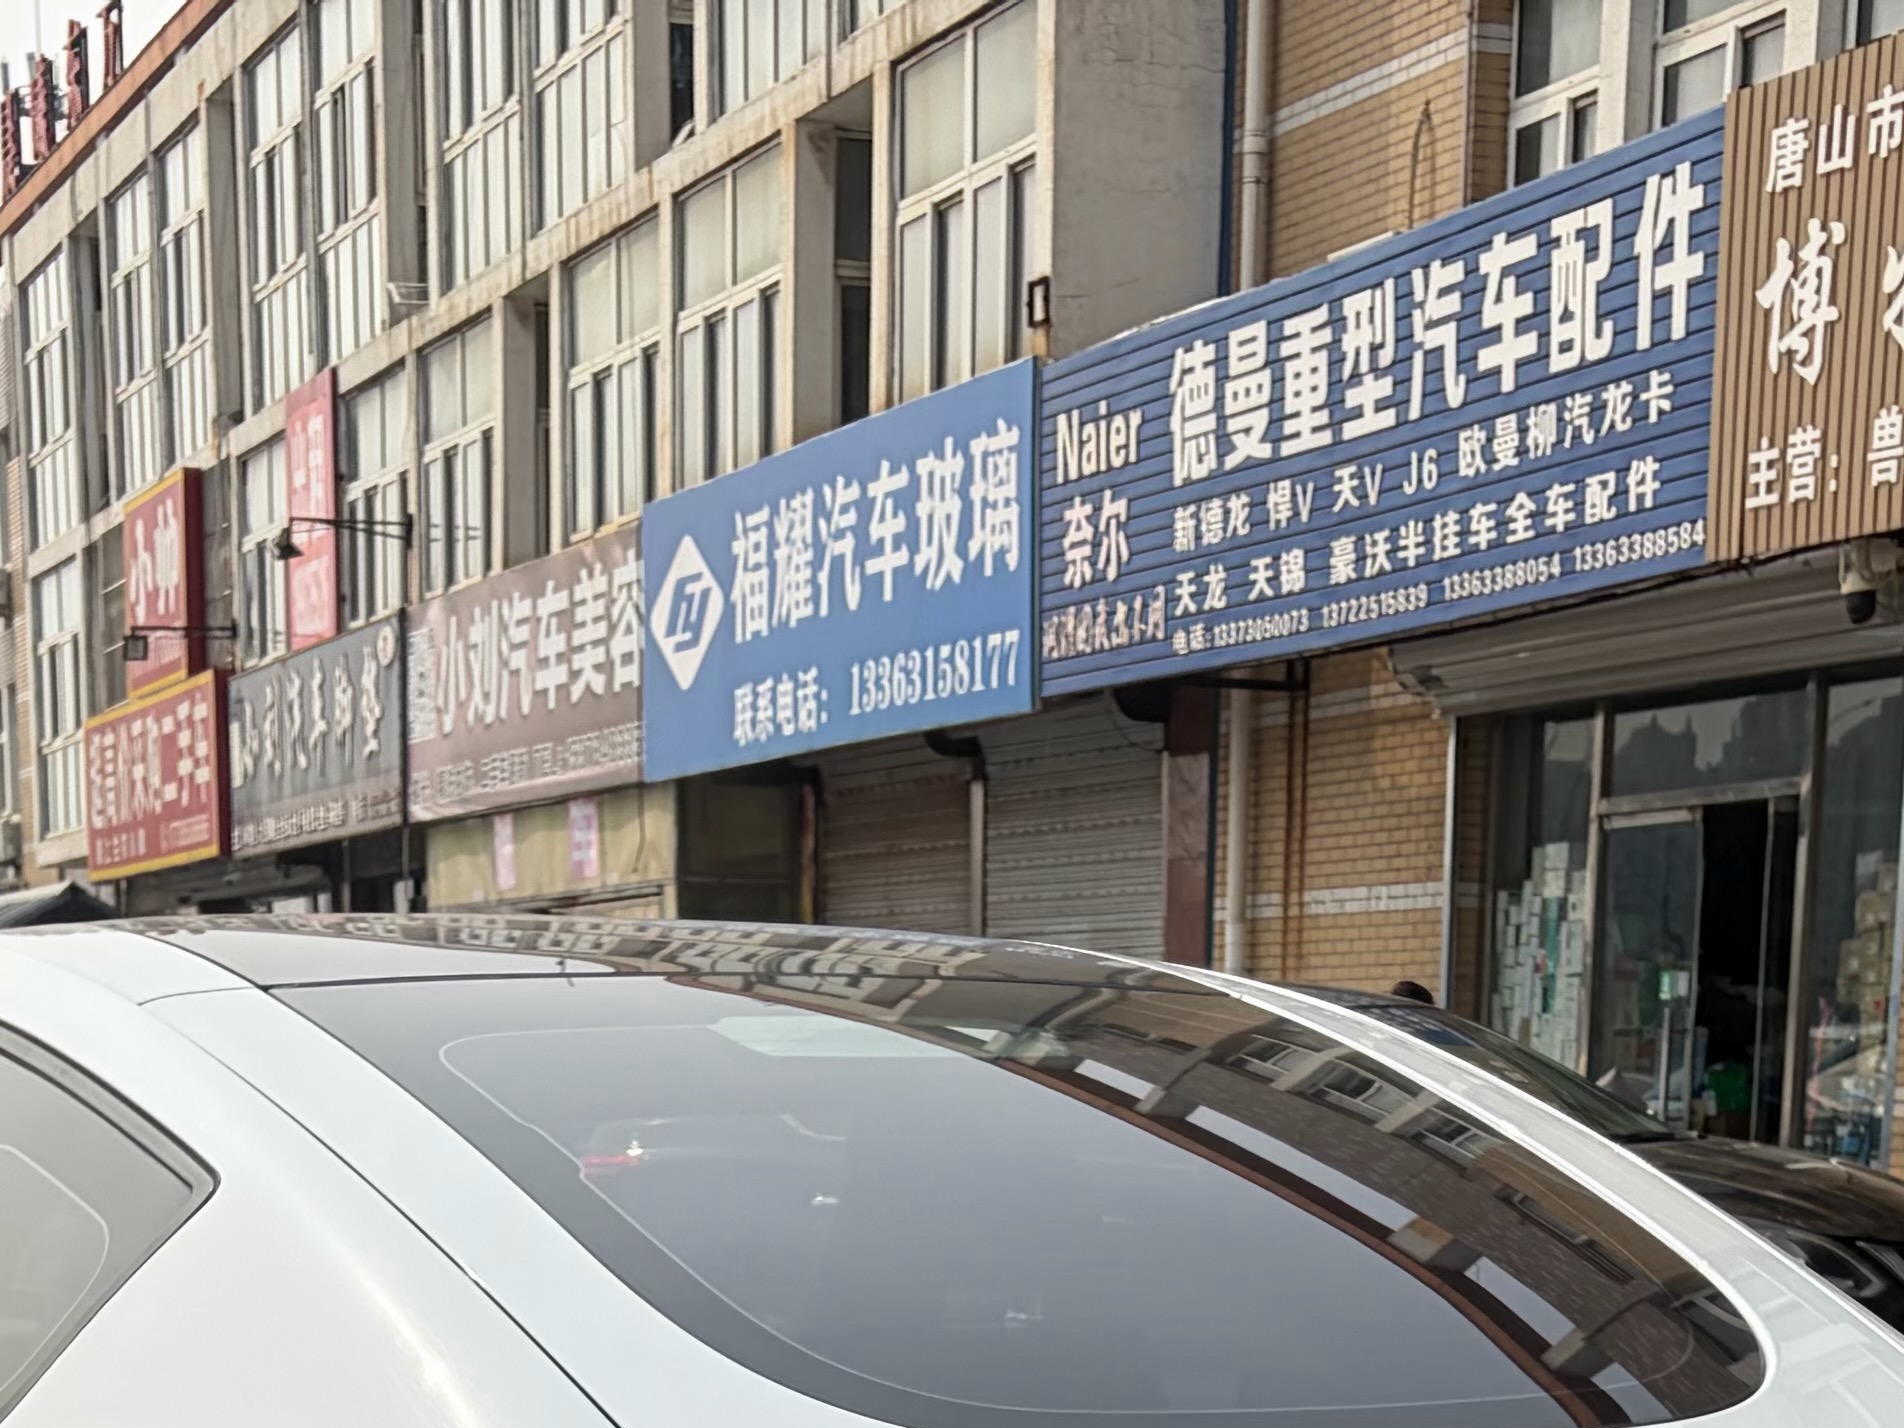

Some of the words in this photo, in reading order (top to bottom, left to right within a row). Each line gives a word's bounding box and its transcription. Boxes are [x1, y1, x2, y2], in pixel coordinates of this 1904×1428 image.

[1169, 160, 1706, 488] 德曼重型汽车配件
[1055, 400, 1144, 485] Naier
[1332, 463, 1384, 513] 天V
[1402, 448, 1439, 496] J6
[730, 416, 1021, 645] 福耀汽车玻璃
[1062, 488, 1130, 589] 奈尔
[1173, 561, 1228, 618] 天龙
[1328, 455, 1662, 587] 豪沃半挂车全车配件
[1442, 551, 1562, 602] 13363388054
[1572, 518, 1707, 573] 13363388584
[436, 547, 645, 737] 小刘汽车美容
[847, 628, 1021, 717] 13363158177
